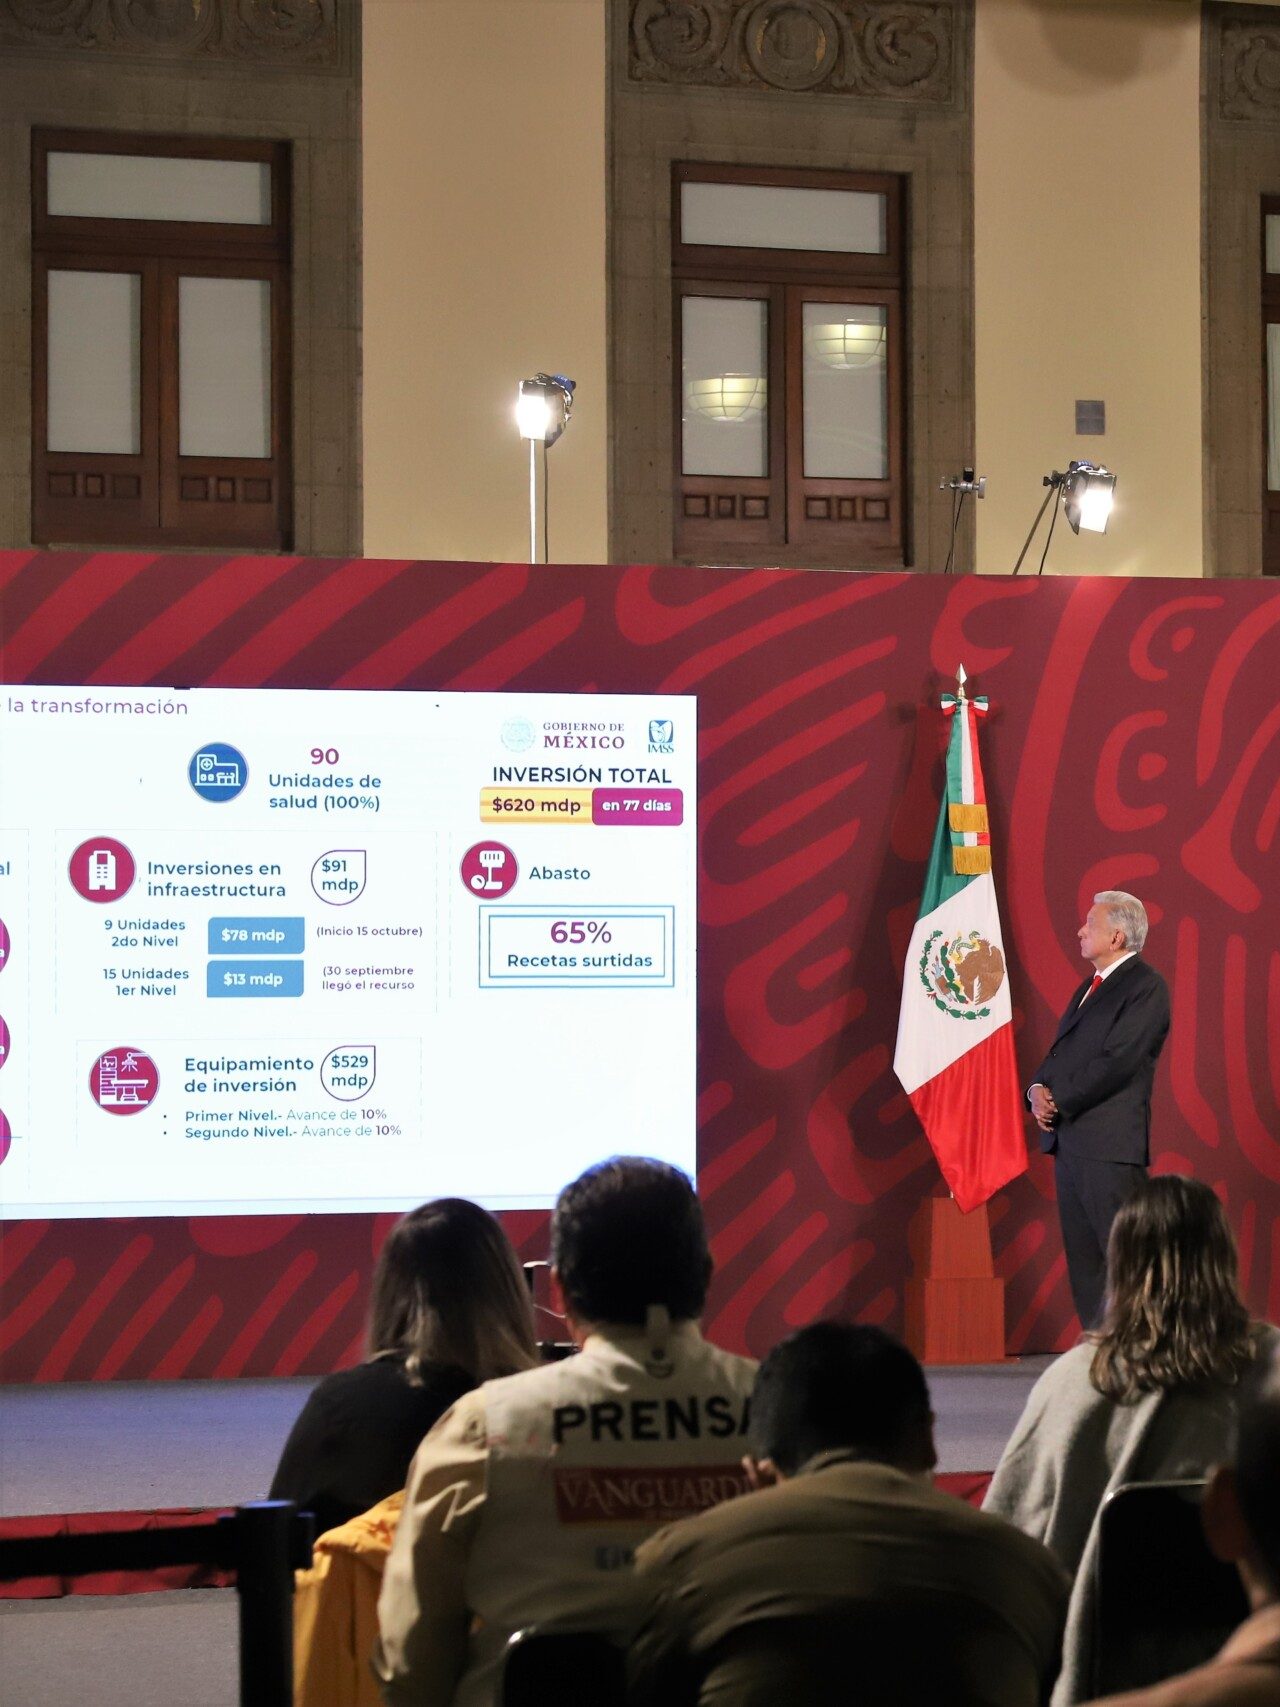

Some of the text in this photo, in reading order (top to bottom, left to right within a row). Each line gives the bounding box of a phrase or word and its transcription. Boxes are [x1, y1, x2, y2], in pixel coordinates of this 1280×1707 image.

[9, 698, 187, 714] la transformación
[542, 722, 625, 732] GOBIERNO DE
[544, 732, 624, 749] MÉXICO
[647, 743, 675, 754] IMSS
[311, 748, 339, 765] 90
[269, 773, 381, 788] Unidades de
[494, 765, 672, 783] INVERSIÓN TOTAL
[270, 795, 379, 812] salud (100%)
[493, 797, 580, 815] $620 mdp
[601, 799, 673, 812] en 77 días
[148, 861, 281, 876] Inversiones en
[321, 859, 347, 873] $91
[529, 866, 590, 880] Abasto
[148, 882, 285, 896] infraestructura
[322, 878, 359, 893] mdp
[104, 918, 186, 931] 9 Unidades
[316, 925, 423, 938] (Inicio 15 octubre)
[222, 928, 285, 943] $78 mdp
[551, 921, 611, 944] 65%
[111, 934, 179, 948] 2do Nivel
[507, 953, 652, 968] Recetas surtidas
[102, 967, 190, 980] 15 Unidades
[322, 965, 414, 978] (30 septiembre
[224, 972, 284, 987] $13 mdp
[322, 980, 416, 992] llegó el recurso
[115, 983, 177, 996] 1er Nivel
[186, 1056, 314, 1074] Equipamiento
[331, 1054, 368, 1069] $529
[185, 1078, 296, 1092] de inversión
[331, 1074, 368, 1090] mdp
[185, 1109, 234, 1122] Primer
[286, 1108, 337, 1121] Avance
[339, 1108, 358, 1121] de
[360, 1108, 387, 1120] 10%
[186, 1127, 249, 1140] Segundo
[301, 1124, 352, 1137] Avance
[354, 1124, 373, 1137] de
[375, 1124, 402, 1136] 10%
